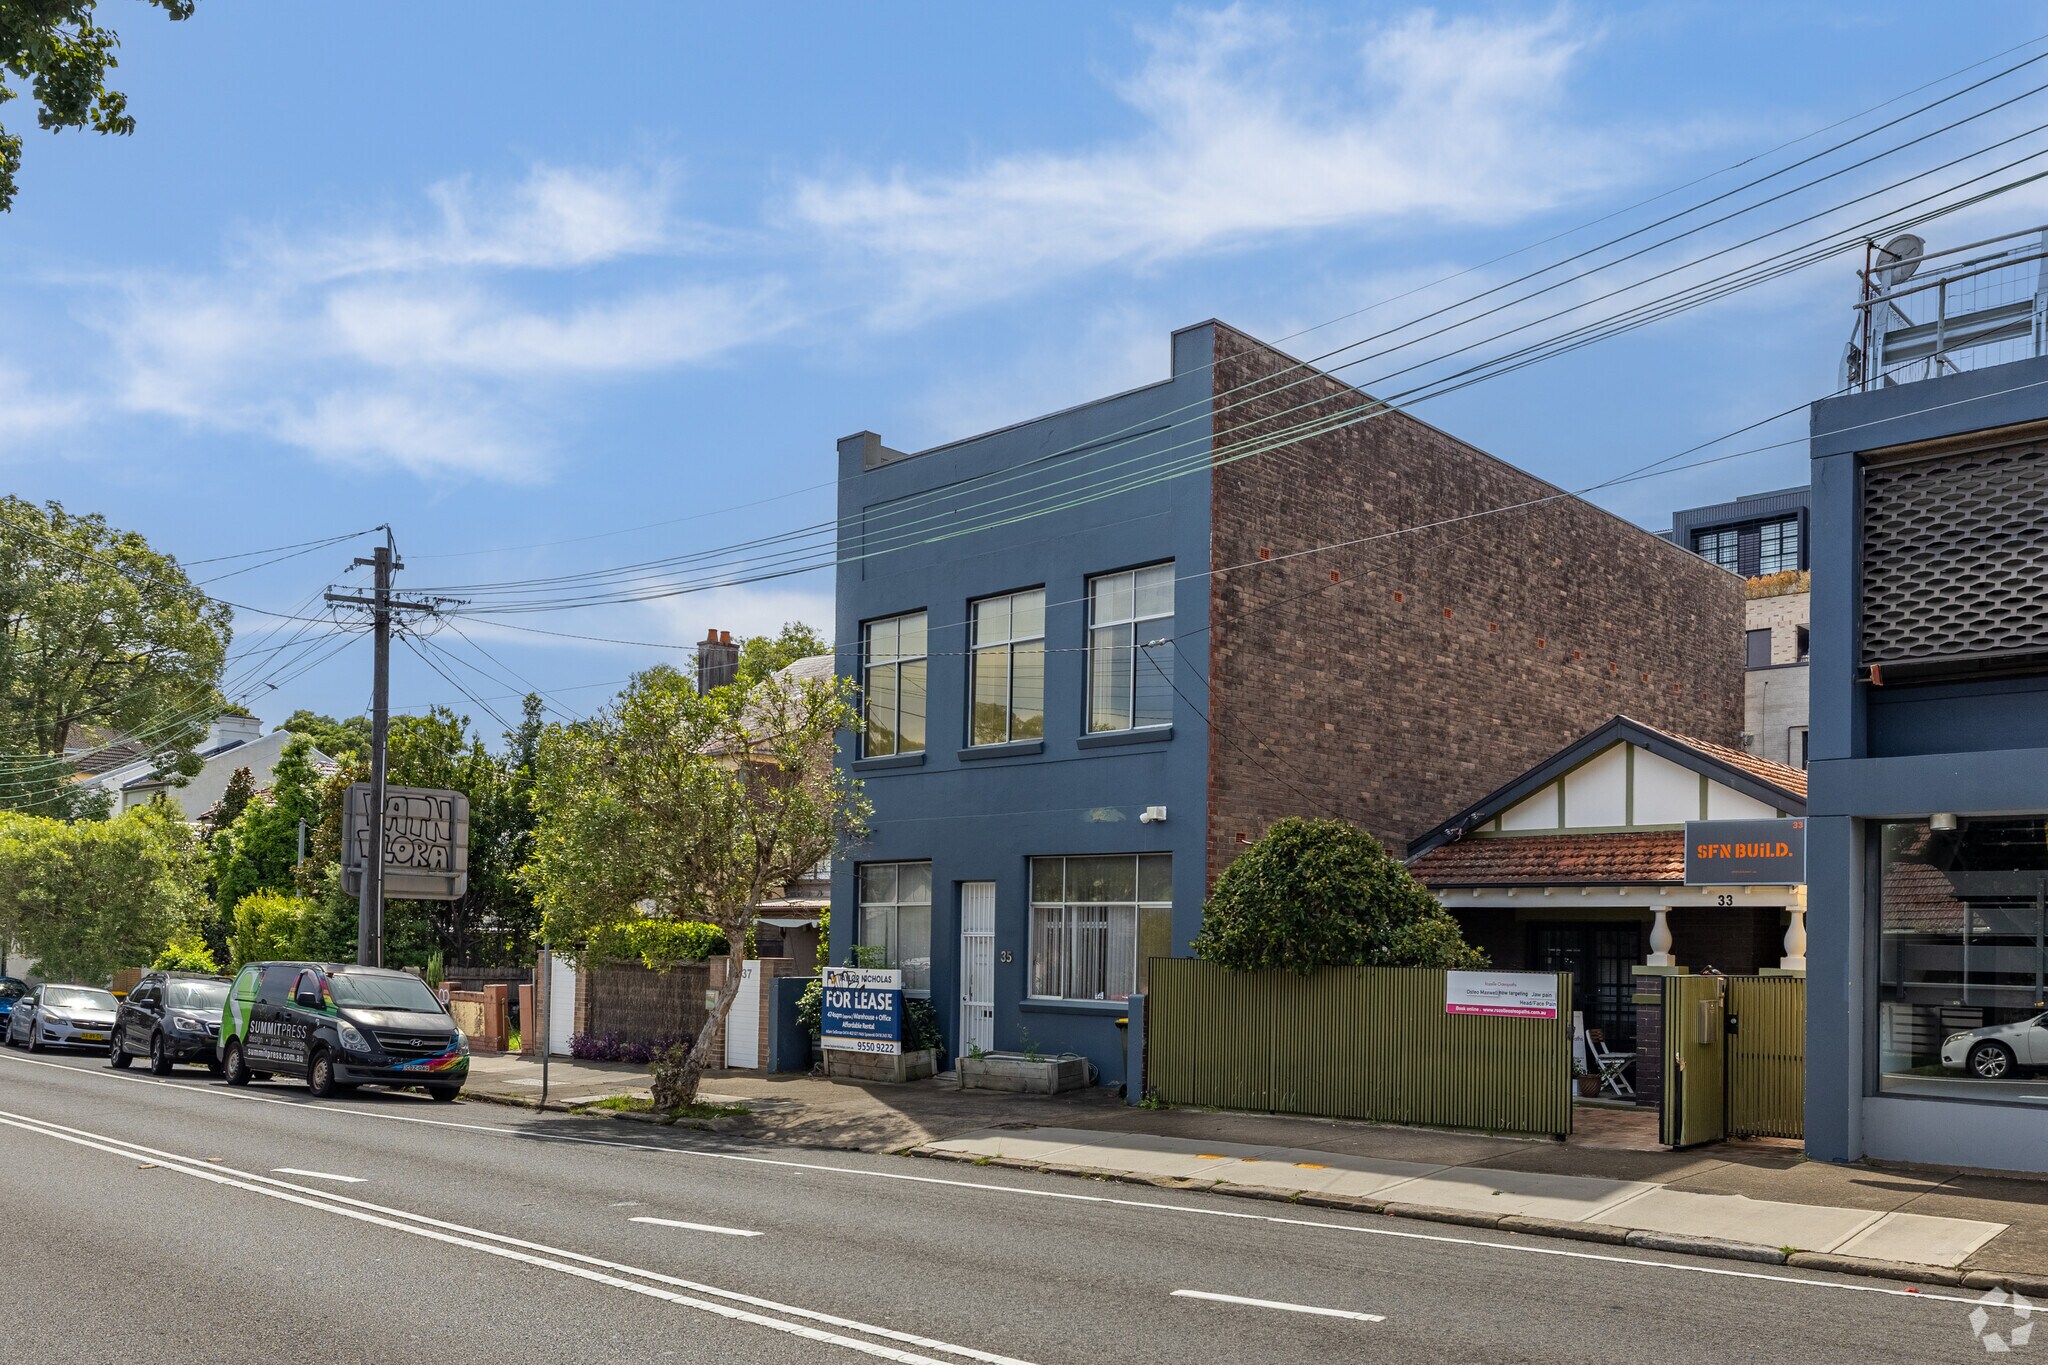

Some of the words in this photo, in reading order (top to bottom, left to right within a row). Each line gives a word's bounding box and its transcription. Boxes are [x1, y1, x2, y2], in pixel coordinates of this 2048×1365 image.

[362, 793, 451, 842] ATN
[1697, 843, 1732, 859] SFN
[1717, 894, 1733, 906] 33
[1000, 950, 1013, 963] 35
[742, 968, 753, 979] 37
[861, 975, 892, 984] NICHOLAS
[826, 991, 851, 1008] FOR
[855, 992, 893, 1011] LEASE
[879, 1014, 892, 1022] Office
[249, 1020, 307, 1039] SUMMITPRESS
[248, 1034, 263, 1045] design
[270, 1036, 281, 1046] print
[288, 1041, 305, 1051] signage
[857, 1041, 874, 1052] 9550
[876, 1043, 894, 1054] 9222
[248, 1049, 303, 1062] summitpress.com.au
